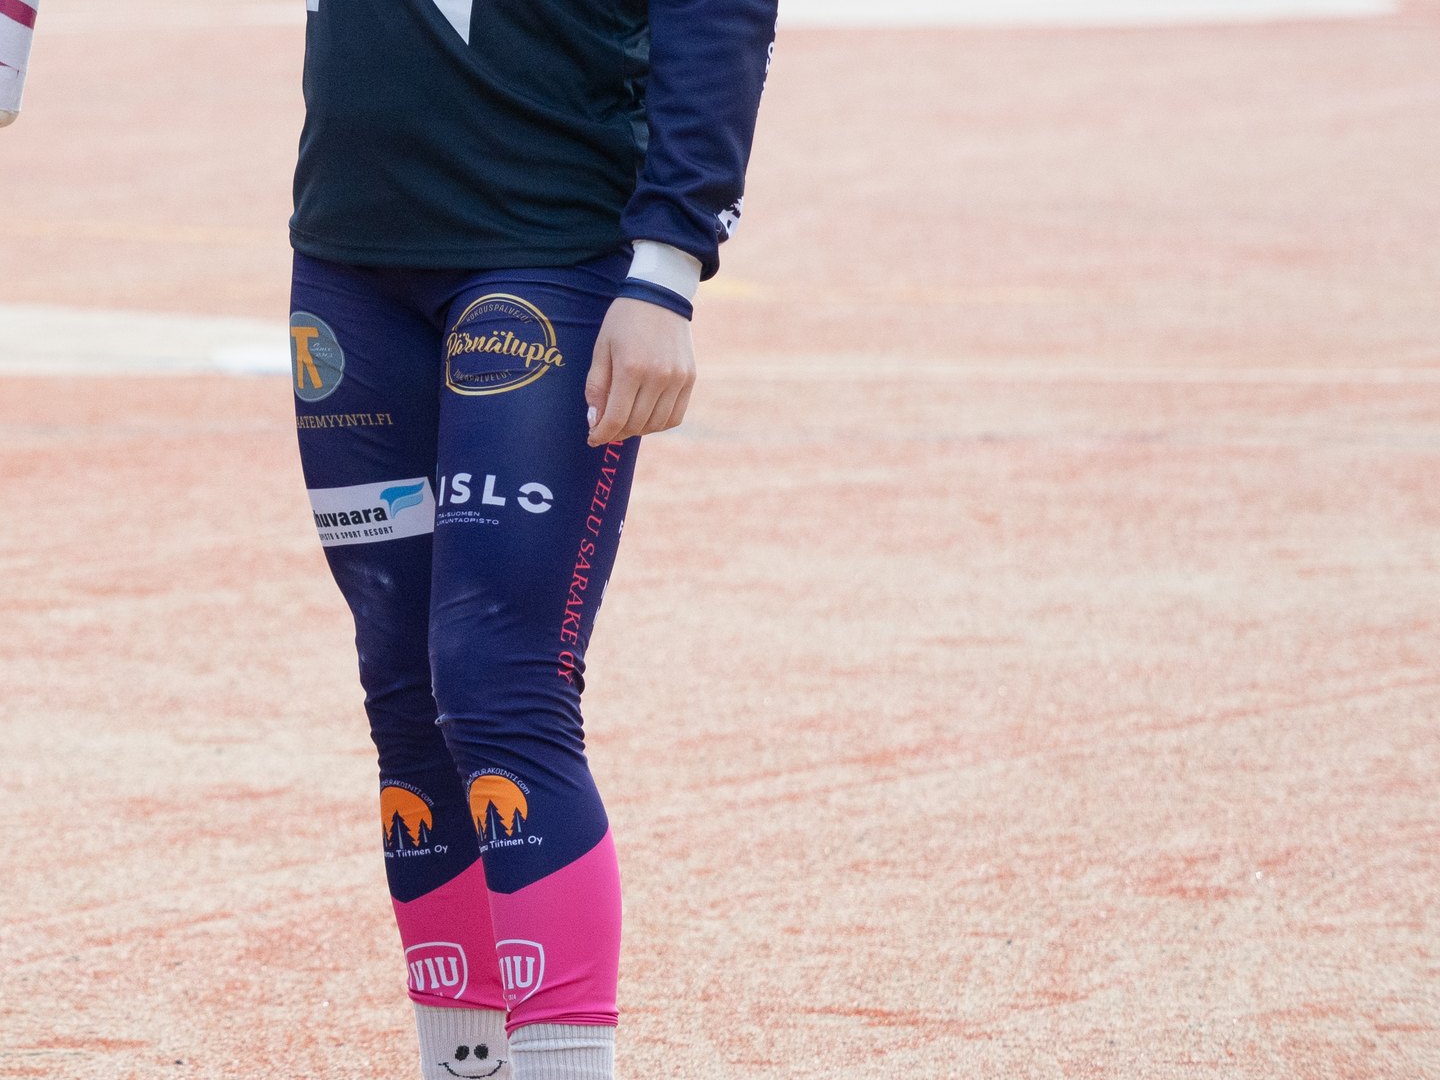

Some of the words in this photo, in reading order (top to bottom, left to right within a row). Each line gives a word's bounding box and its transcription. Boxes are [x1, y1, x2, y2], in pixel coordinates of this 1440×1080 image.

[446, 330, 566, 369] Pärnätupa
[363, 526, 394, 537] RESORT
[560, 538, 595, 646] SARAKE
[396, 847, 432, 858] Tiitinen
[433, 844, 449, 854] Oy
[489, 838, 524, 849] Tiitinen
[527, 834, 544, 846] Oy
[409, 956, 460, 992] VIU
